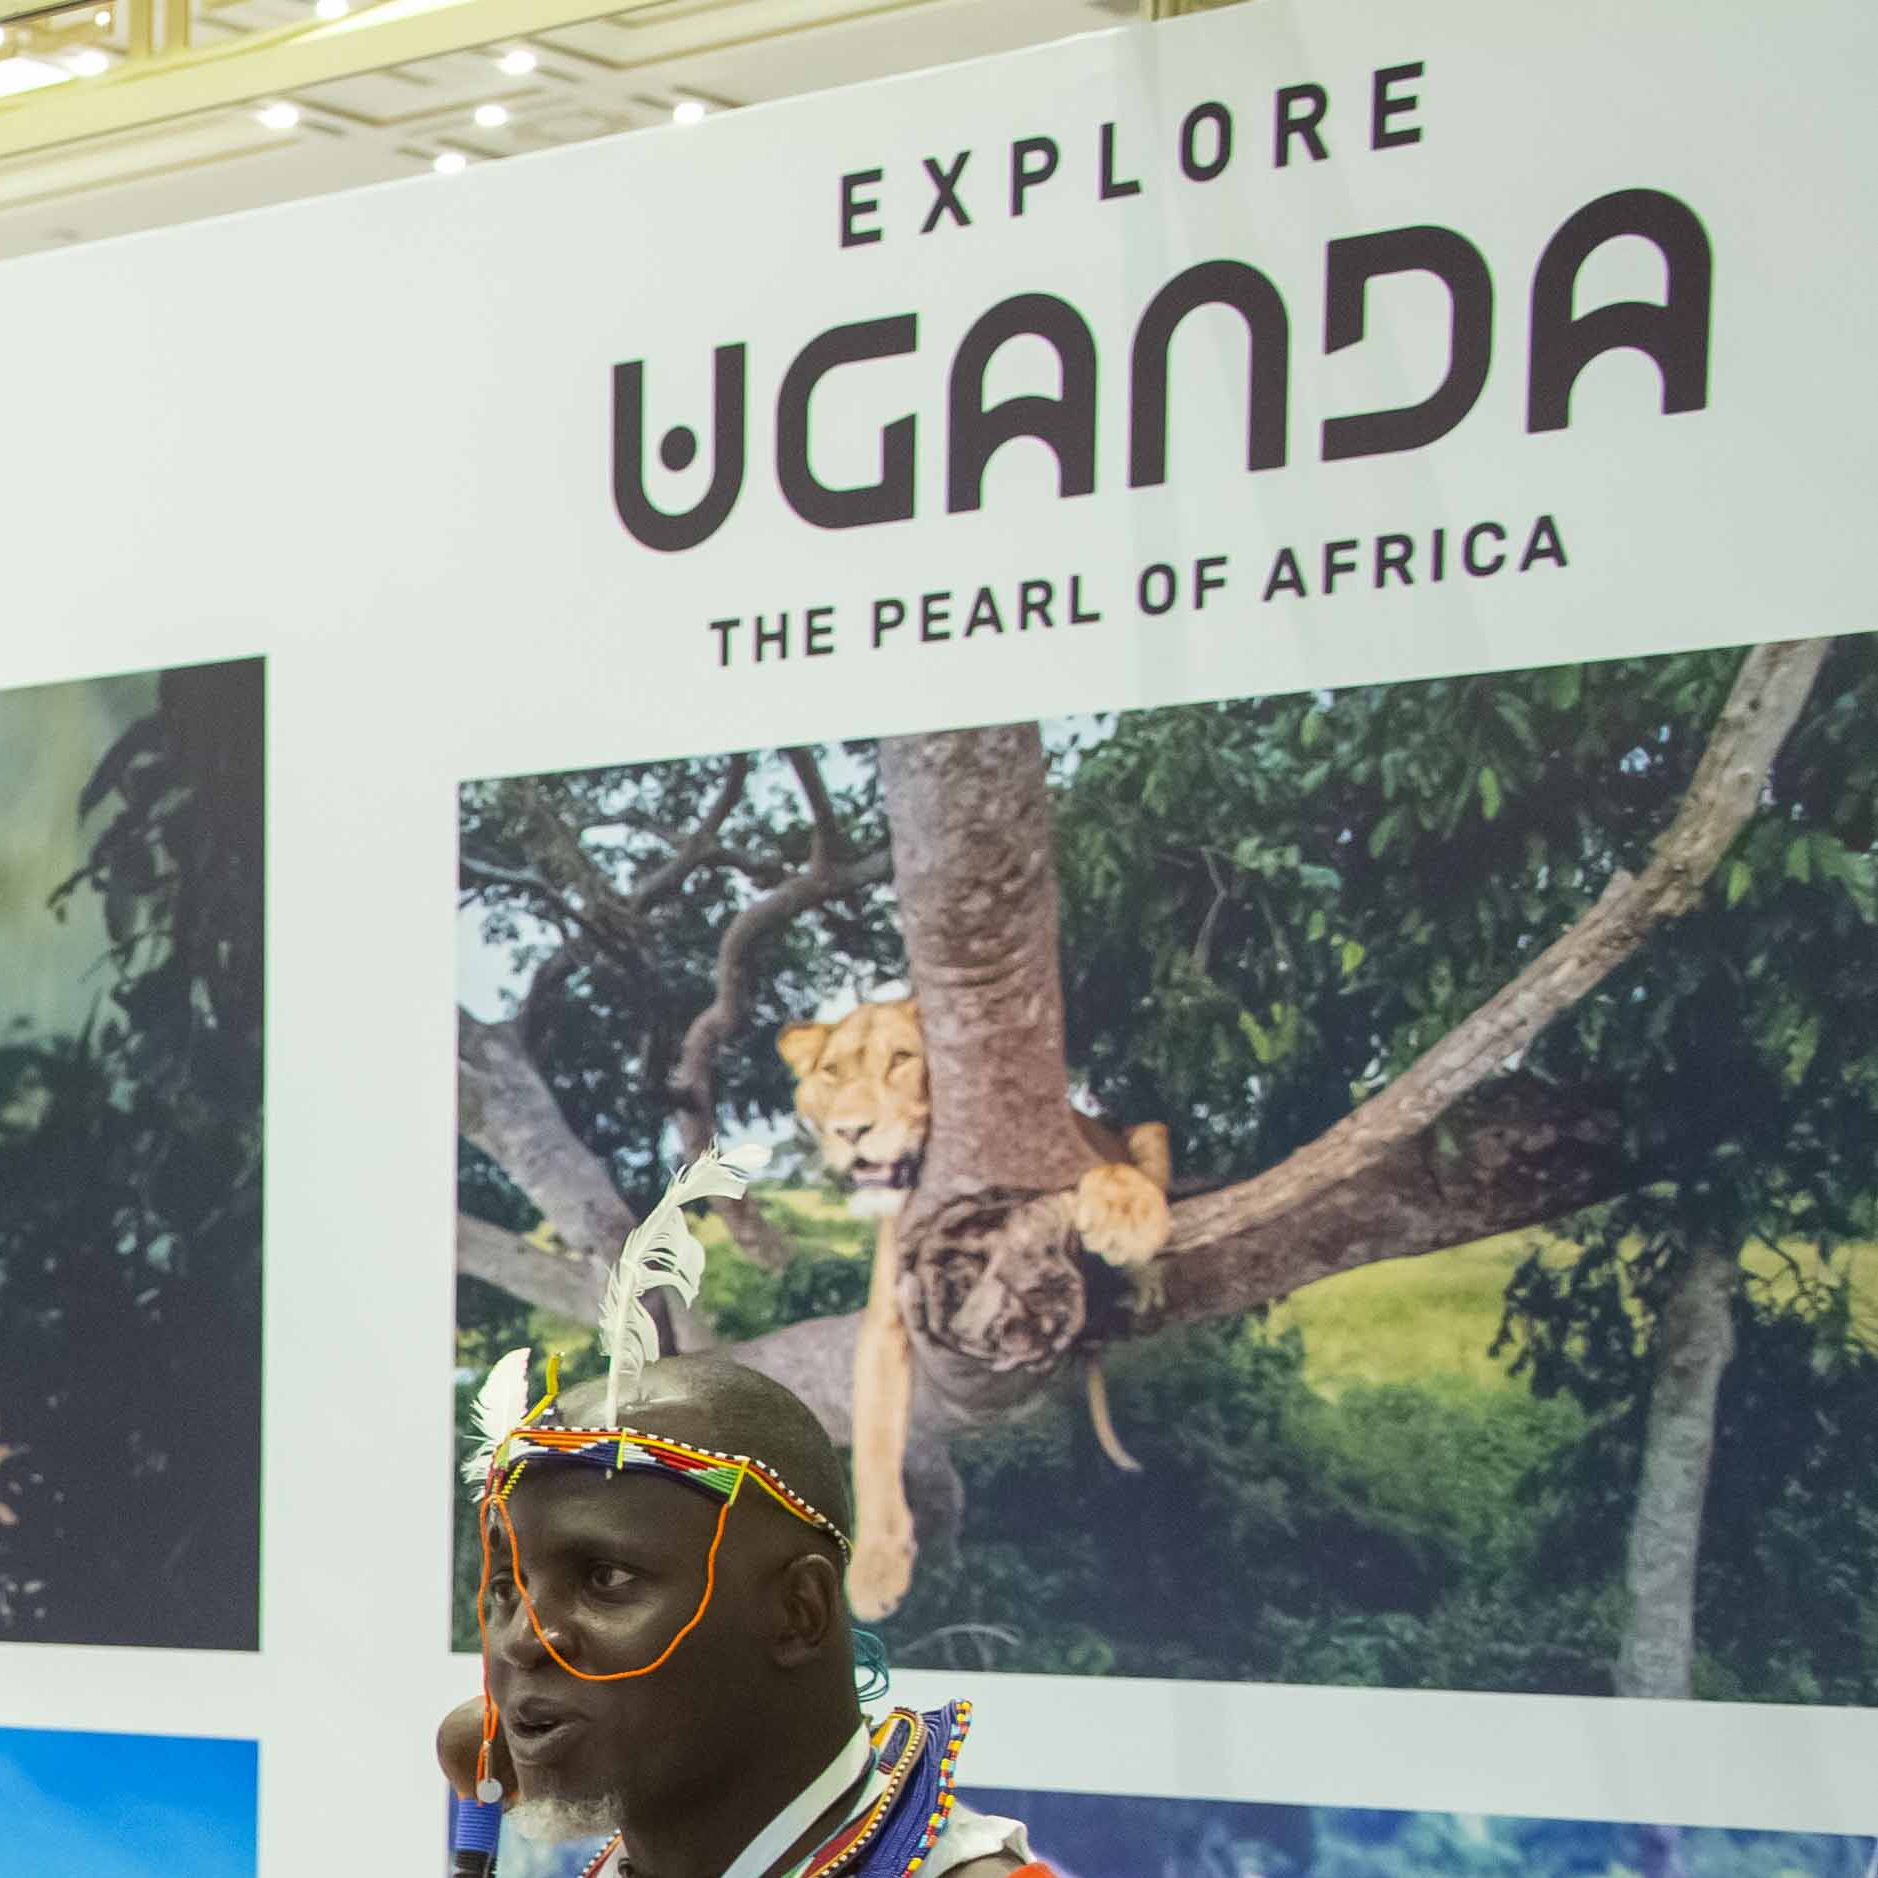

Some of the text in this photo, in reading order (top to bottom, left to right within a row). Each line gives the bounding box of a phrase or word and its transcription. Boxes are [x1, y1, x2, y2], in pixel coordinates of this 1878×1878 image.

[841, 59, 1426, 249] EXPLORE
[612, 186, 1715, 553] UGANDA
[710, 513, 1571, 668] THE PEARL OF AFRICA
